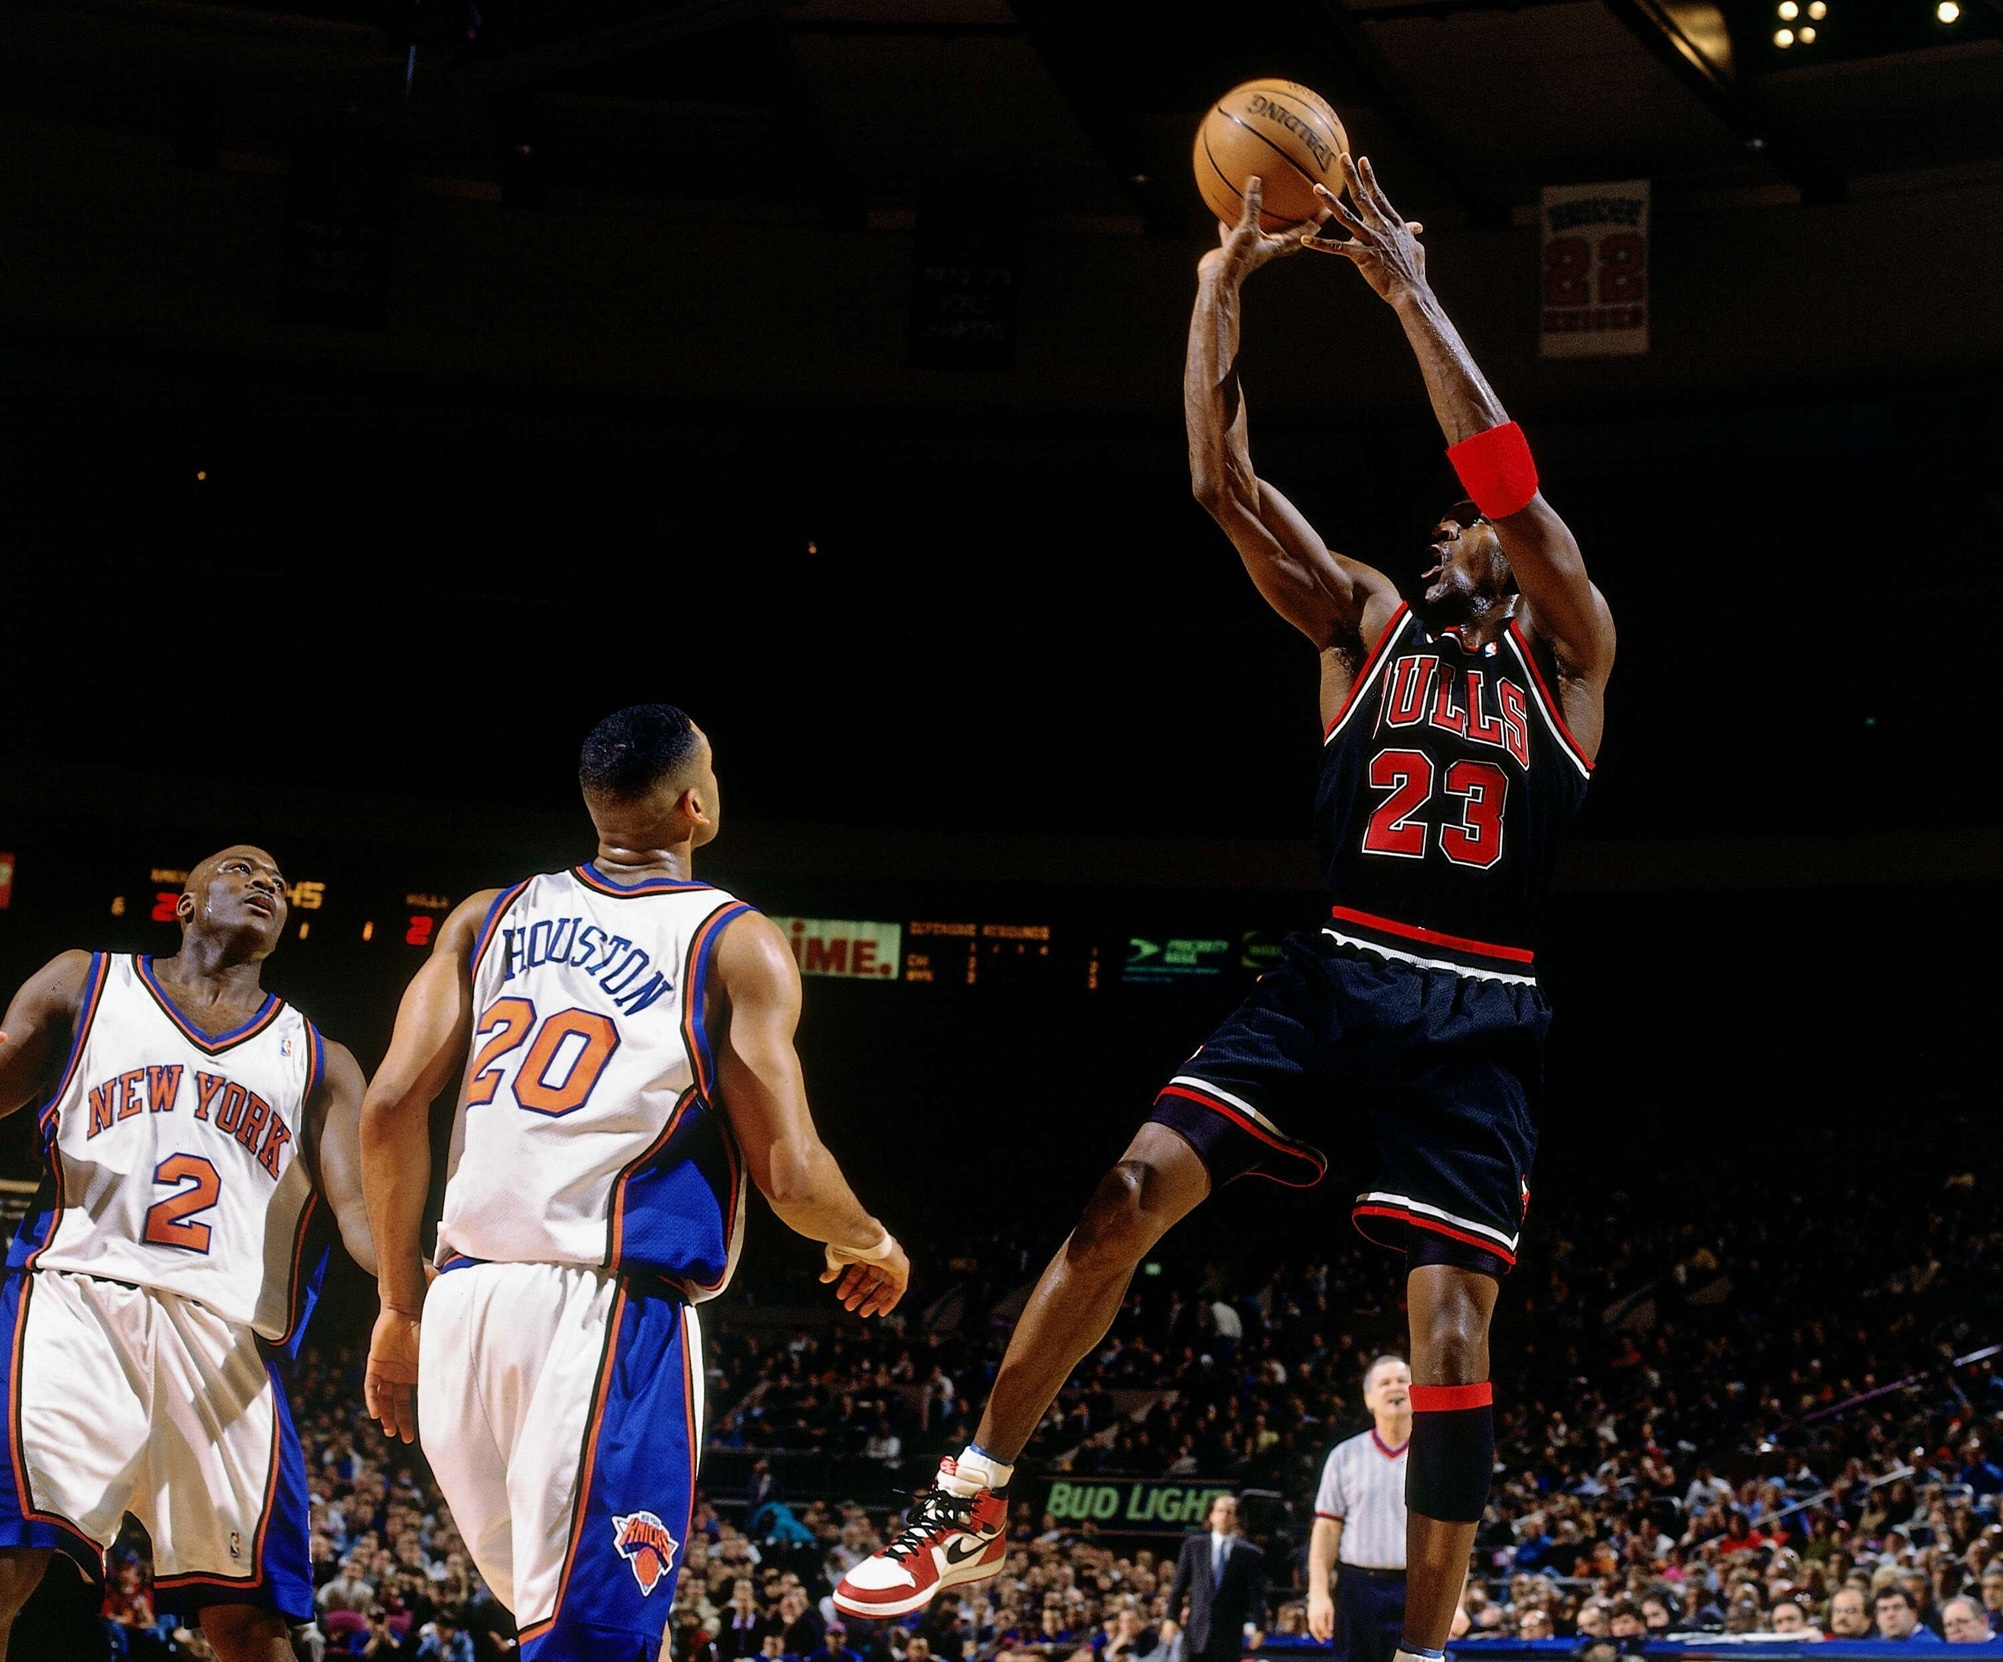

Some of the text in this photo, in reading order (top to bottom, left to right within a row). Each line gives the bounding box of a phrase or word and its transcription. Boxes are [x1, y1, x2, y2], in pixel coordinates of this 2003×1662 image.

[1373, 653, 1530, 771] ULLS
[1361, 748, 1510, 870] 23
[502, 917, 674, 1017] HOUSTON
[466, 996, 621, 1118] 20
[86, 1064, 292, 1181] NEW YORK
[139, 1152, 222, 1255] 2
[619, 1517, 671, 1566] KNICKS
[1046, 1482, 1119, 1519] BUD
